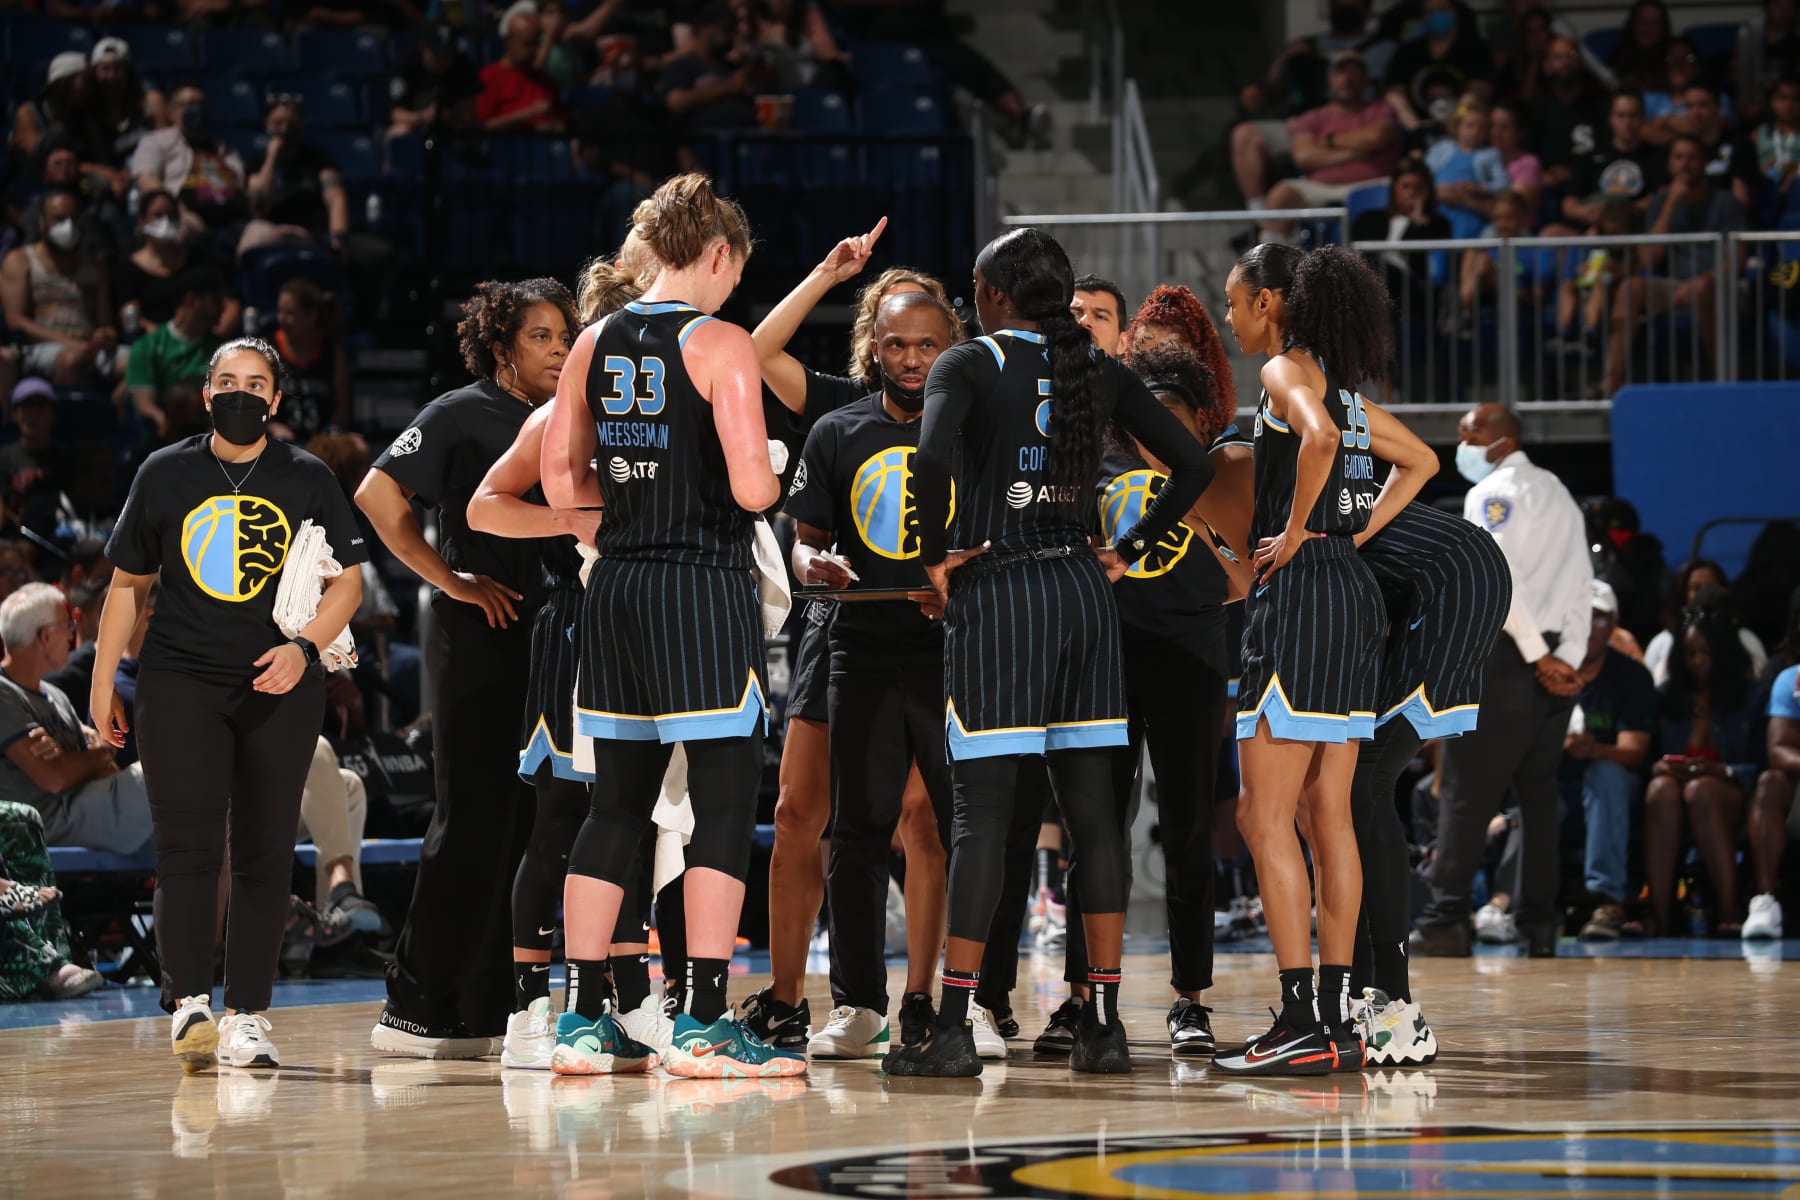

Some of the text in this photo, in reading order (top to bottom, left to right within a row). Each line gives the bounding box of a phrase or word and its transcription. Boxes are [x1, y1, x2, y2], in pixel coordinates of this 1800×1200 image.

[601, 355, 666, 416] 33
[1338, 388, 1371, 450] 35
[1018, 445, 1053, 472] COP
[380, 753, 428, 773] WNBA
[388, 1014, 428, 1035] VUITTON
